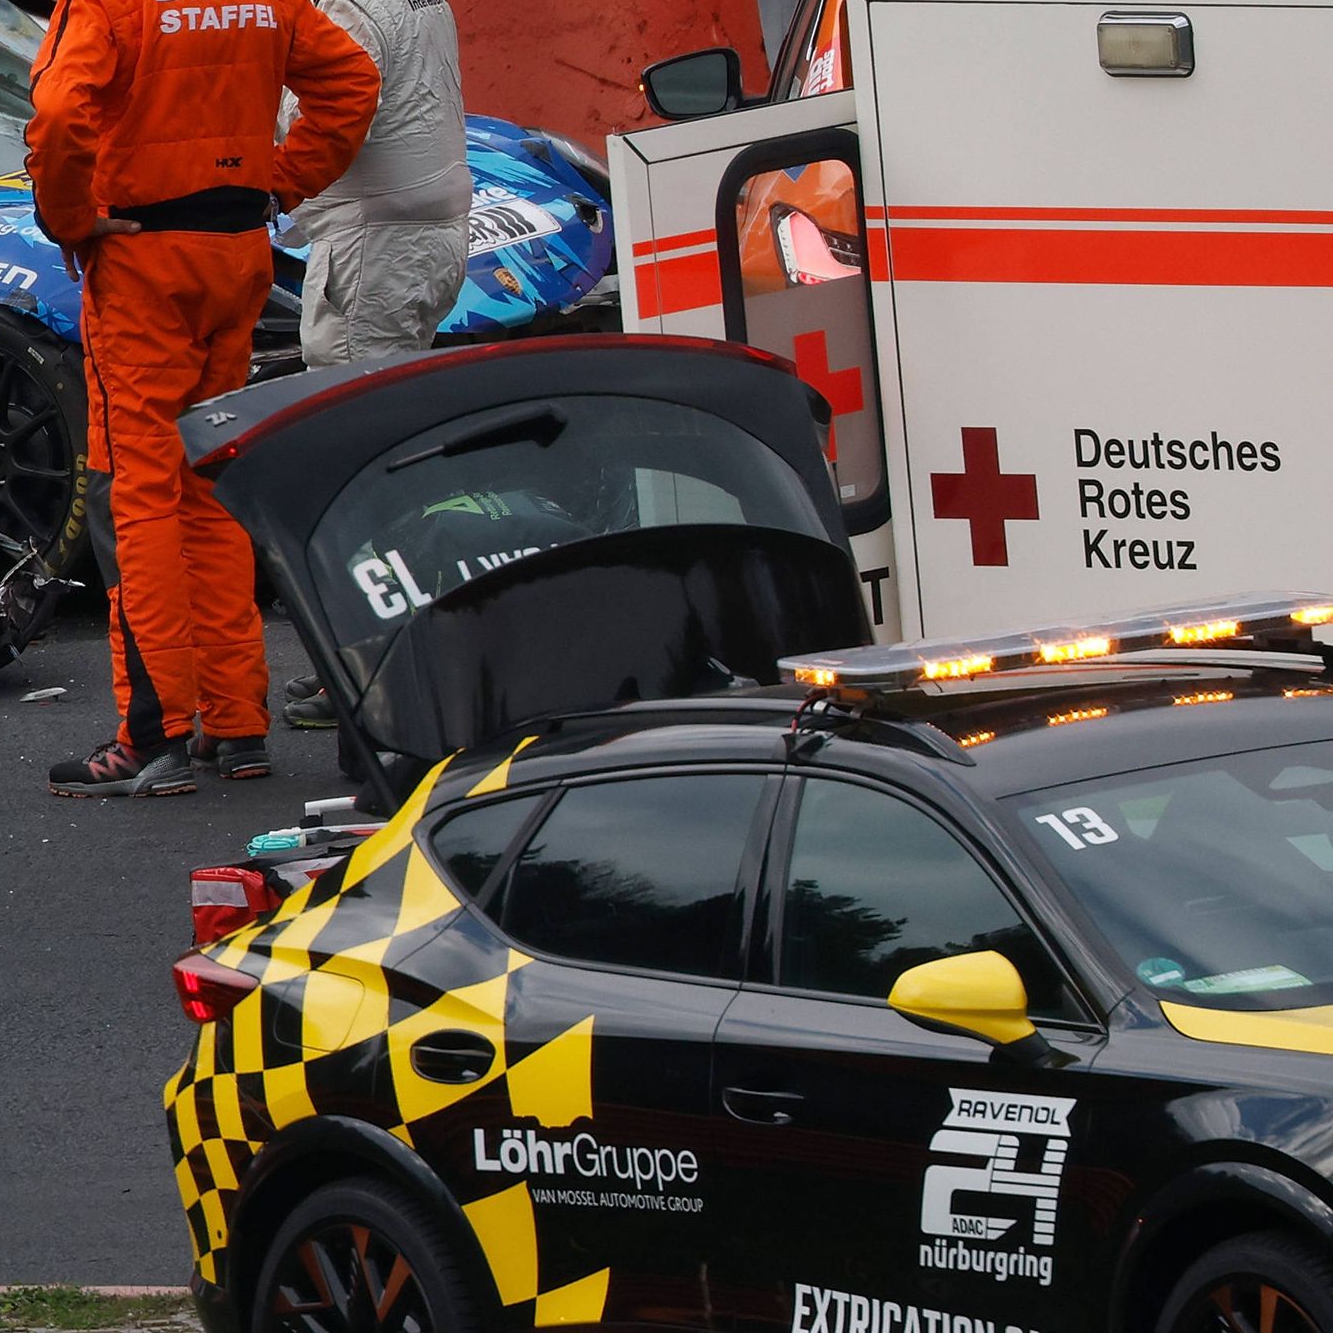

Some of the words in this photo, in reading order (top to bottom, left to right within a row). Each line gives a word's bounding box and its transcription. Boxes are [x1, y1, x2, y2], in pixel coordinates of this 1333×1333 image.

[159, 3, 278, 35] STAFFEL
[1073, 428, 1282, 473] Deutsches
[1078, 479, 1191, 521] Rotes
[1082, 529, 1198, 570] Kreuz
[1035, 806, 1119, 851] 13
[957, 1097, 1062, 1126] RAVENOL
[474, 1126, 699, 1190] LöhrGruppe
[532, 1188, 557, 1204] VAN
[557, 1190, 599, 1207] MOSSEL
[600, 1192, 667, 1211] AUTOMOTIVE
[667, 1196, 704, 1213] GROUP
[951, 1216, 985, 1236] ADAC
[919, 1240, 1053, 1286] nürburgring
